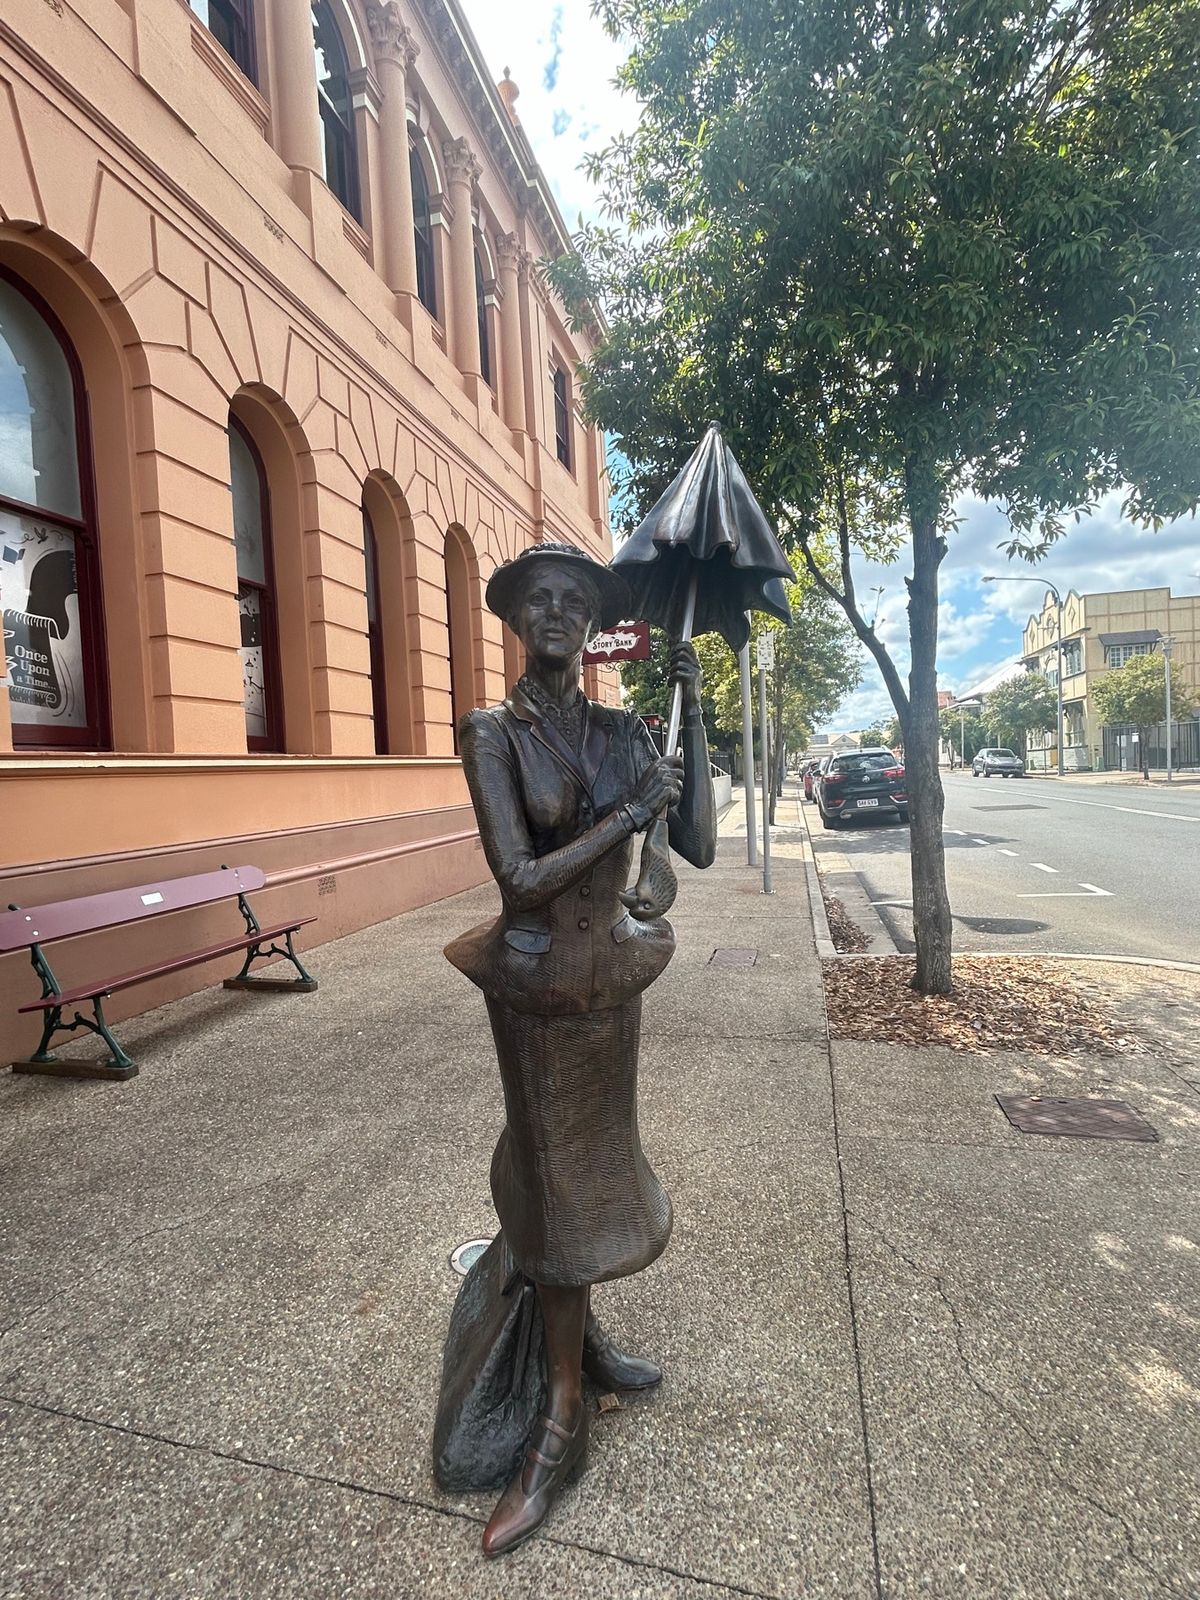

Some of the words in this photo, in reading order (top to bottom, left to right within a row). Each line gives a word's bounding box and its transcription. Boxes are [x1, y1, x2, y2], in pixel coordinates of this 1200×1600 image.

[592, 640, 613, 650] STORY
[615, 639, 632, 647] BANK
[14, 645, 48, 664] Once
[20, 660, 50, 676] Upon
[16, 675, 23, 683] a
